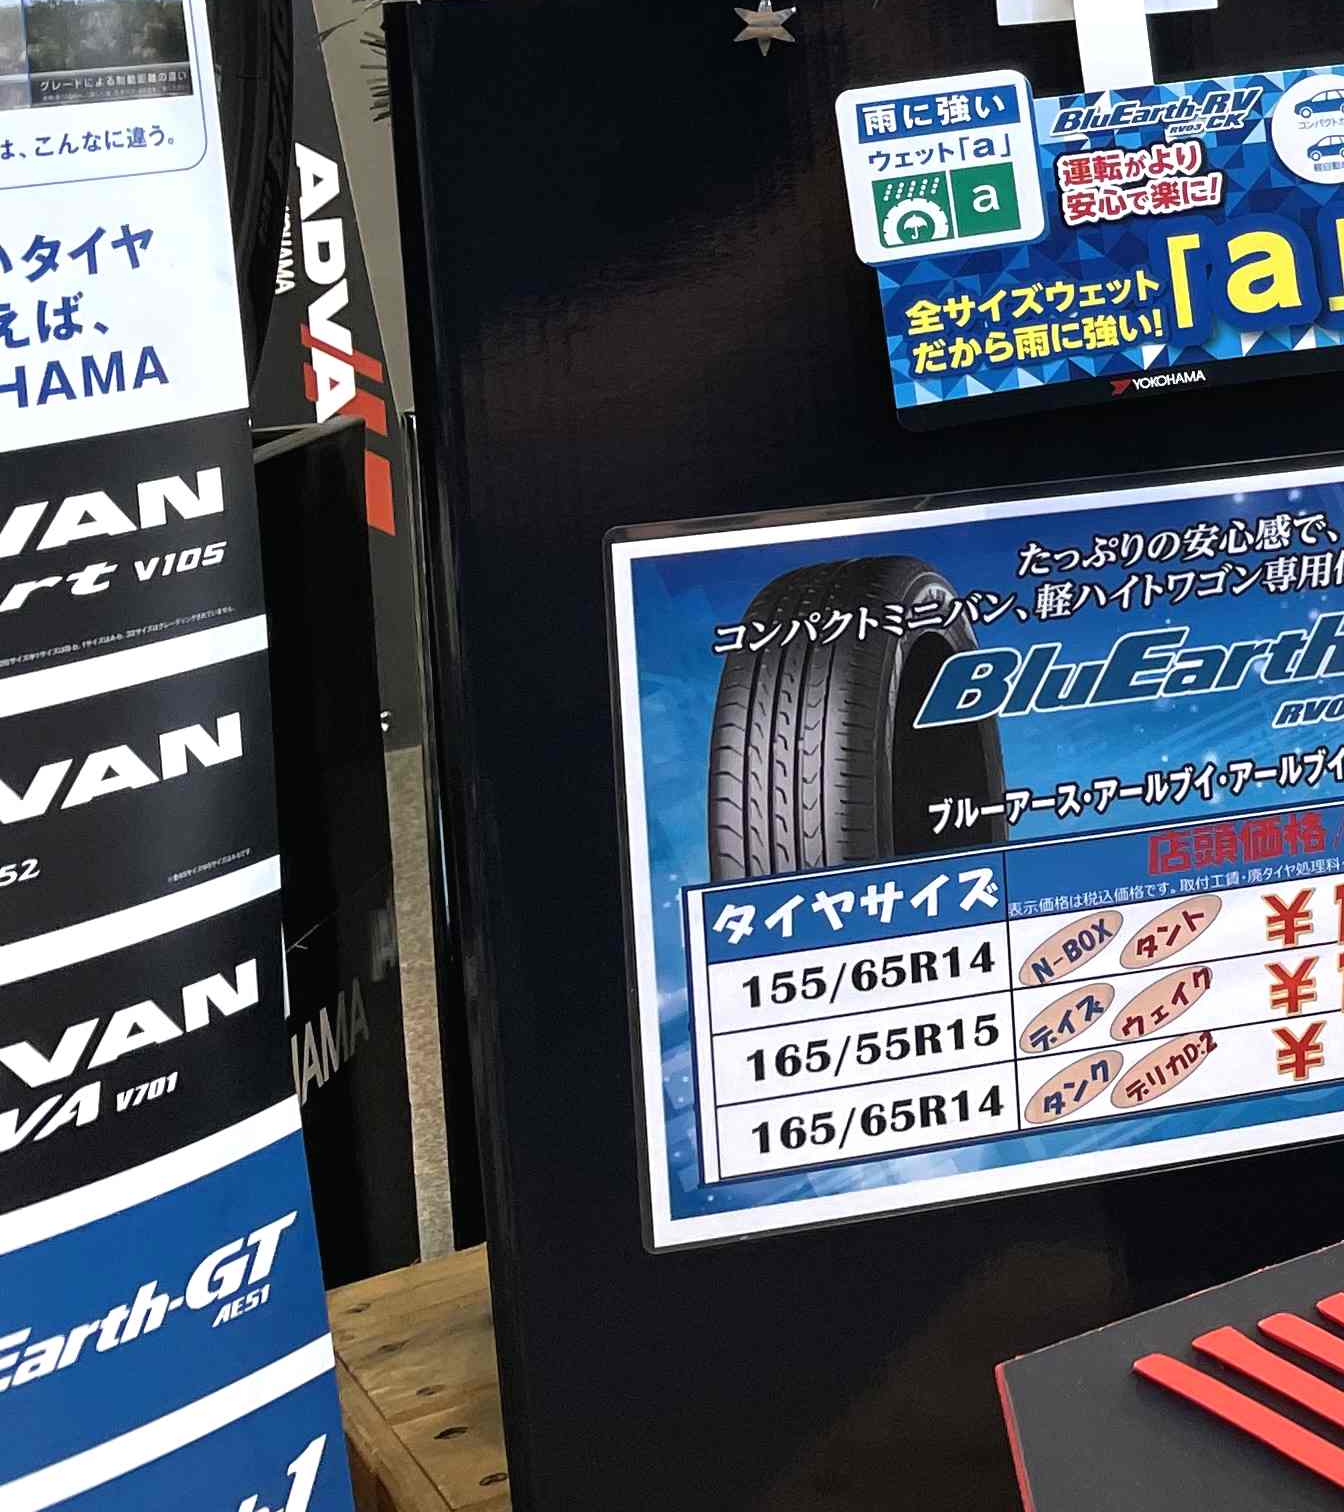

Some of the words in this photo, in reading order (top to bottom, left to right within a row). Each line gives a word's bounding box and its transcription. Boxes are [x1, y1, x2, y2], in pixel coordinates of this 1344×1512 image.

[862, 91, 1007, 136] 雨に強い
[1050, 87, 1263, 136] BluEarth-RV
[1168, 122, 1204, 137] RV03
[1203, 110, 1246, 131] CK
[867, 135, 1014, 173] ウェット「a」
[1060, 142, 1203, 187] 運転がより
[971, 178, 1001, 214] a
[1064, 176, 1221, 222] 安心で楽に!
[905, 268, 1161, 337] 全サイズウェット
[911, 308, 1164, 376] だから雨に強い!
[1131, 368, 1206, 392] YOKOHAMA
[133, 540, 227, 583] V105
[710, 865, 1002, 946] タイヤサイズ
[1135, 909, 1206, 959] タント
[740, 941, 999, 1011] 155/65R14
[1030, 917, 1114, 985] N-BOX
[1028, 994, 1106, 1053] デイズ
[1120, 966, 1212, 1038] ウェイク
[744, 1013, 1002, 1084] 165/55R15
[115, 1071, 179, 1113] V701
[1042, 1058, 1110, 1116] タンク
[750, 1087, 1007, 1157] 165/65R14
[211, 1283, 272, 1329] AE51
